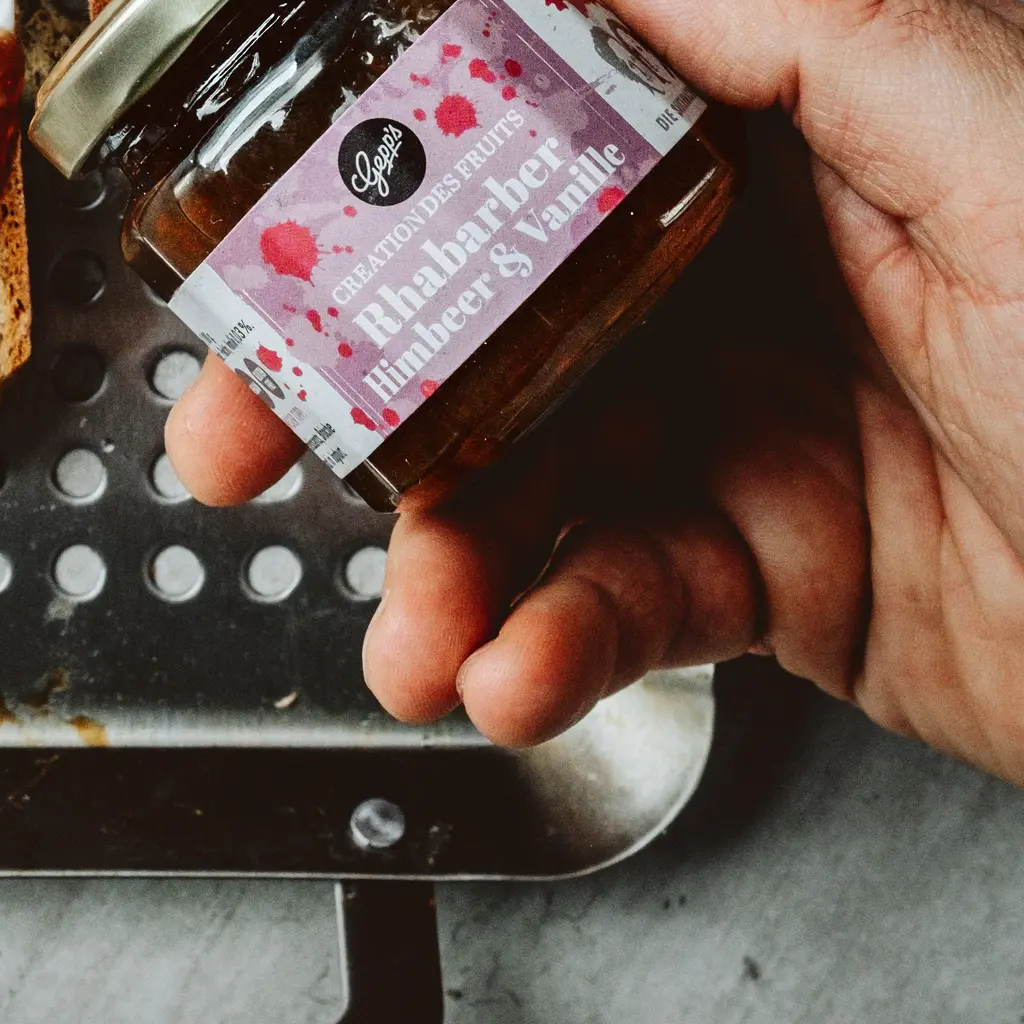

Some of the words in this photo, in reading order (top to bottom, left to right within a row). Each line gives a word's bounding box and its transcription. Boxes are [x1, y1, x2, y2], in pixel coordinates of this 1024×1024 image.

[331, 211, 425, 305] CREATION
[417, 175, 461, 217] DES
[454, 108, 525, 180] FRUITS
[351, 124, 402, 197] Gepp's
[655, 108, 679, 131] DIE
[352, 137, 566, 349] Rhabarber
[363, 272, 500, 403] Himbeer
[489, 242, 533, 278] &
[513, 143, 626, 243] Vanille
